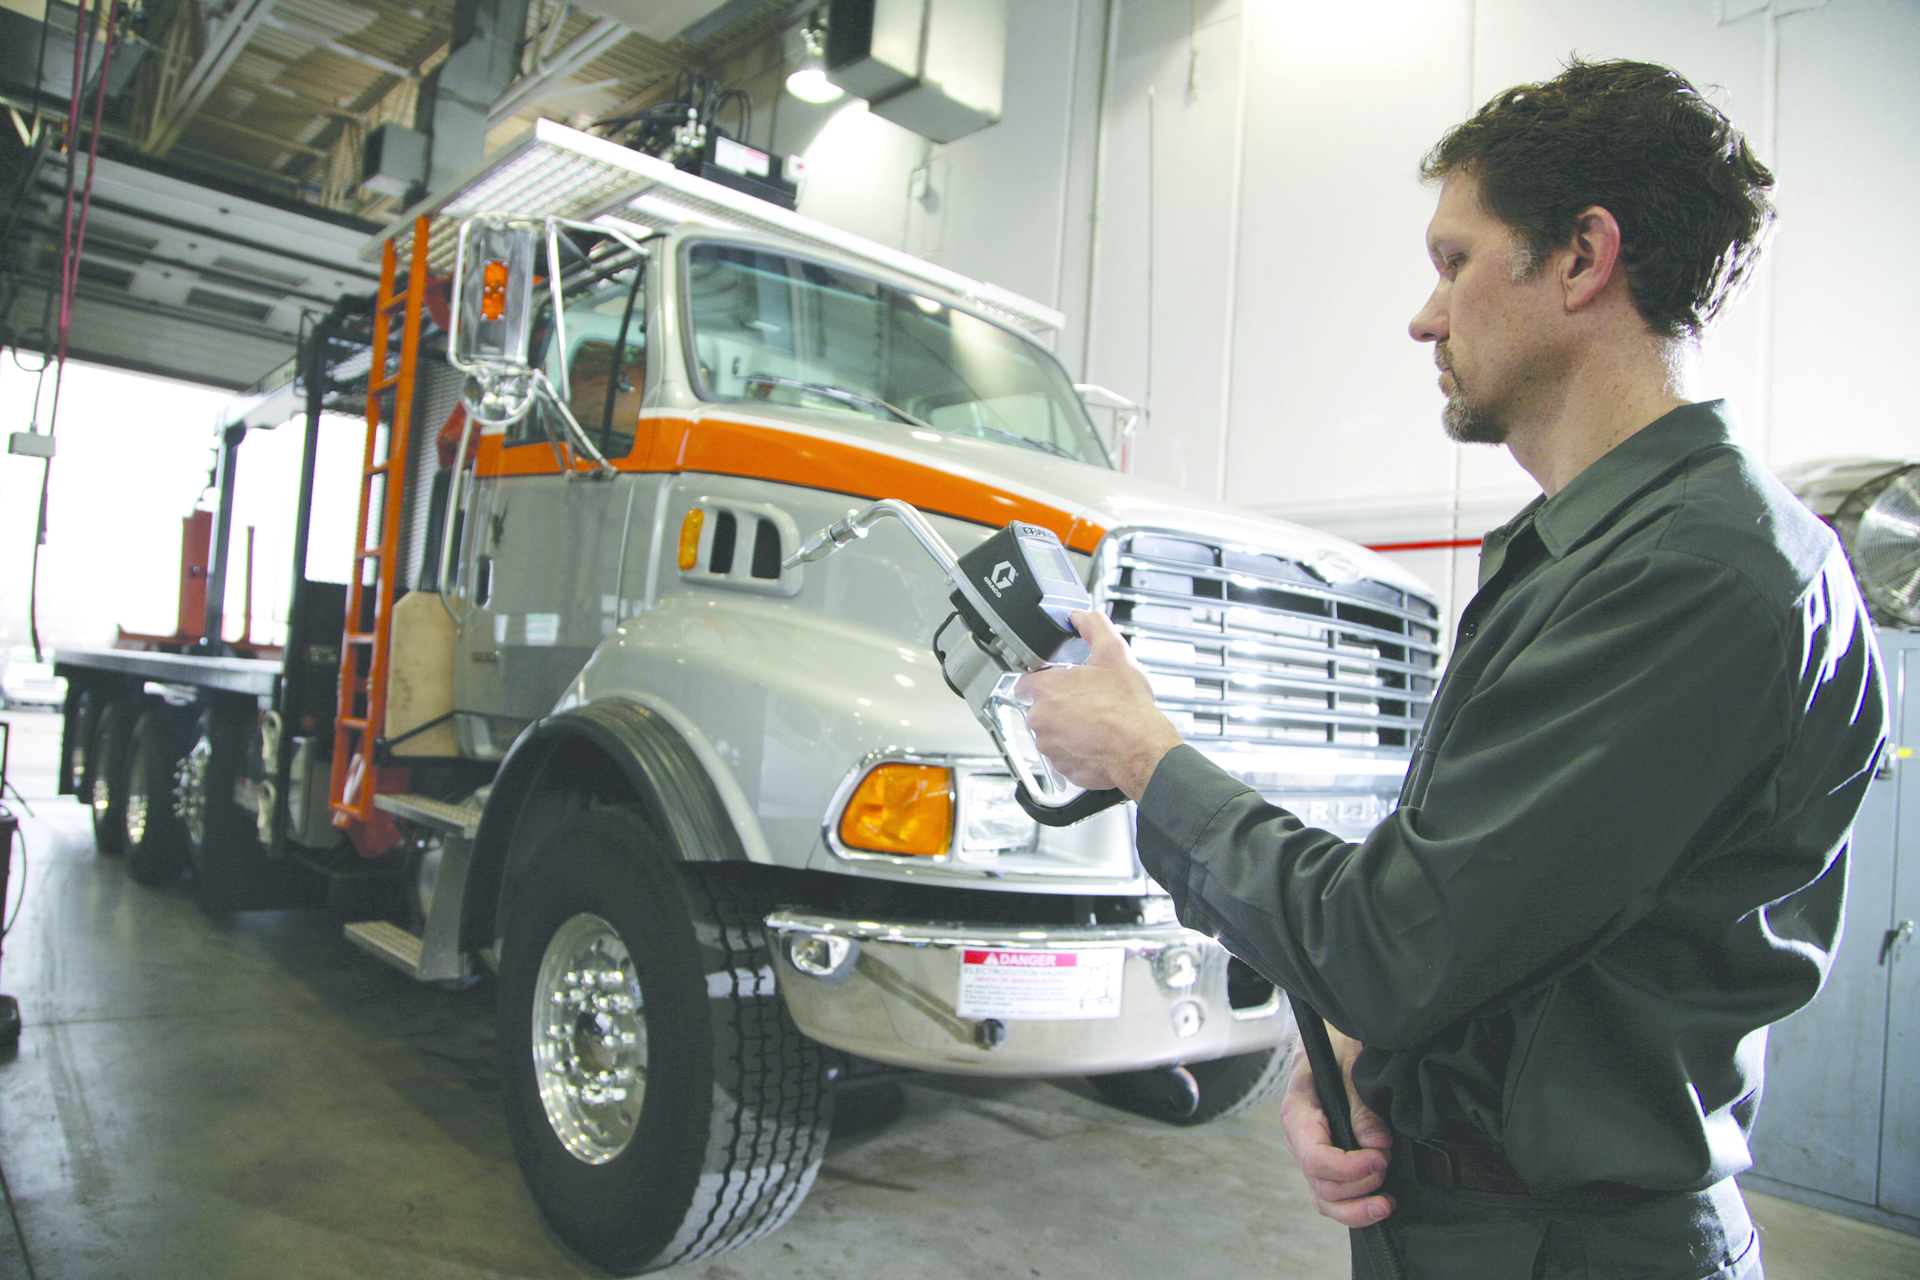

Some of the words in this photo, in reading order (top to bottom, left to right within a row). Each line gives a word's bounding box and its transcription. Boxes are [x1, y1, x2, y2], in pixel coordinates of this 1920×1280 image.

[983, 576, 1002, 599] GRACO
[1000, 953, 1057, 967] DANGER
[964, 966, 1039, 977] ELECTROCUTION
[1041, 969, 1076, 977] HAZARD
